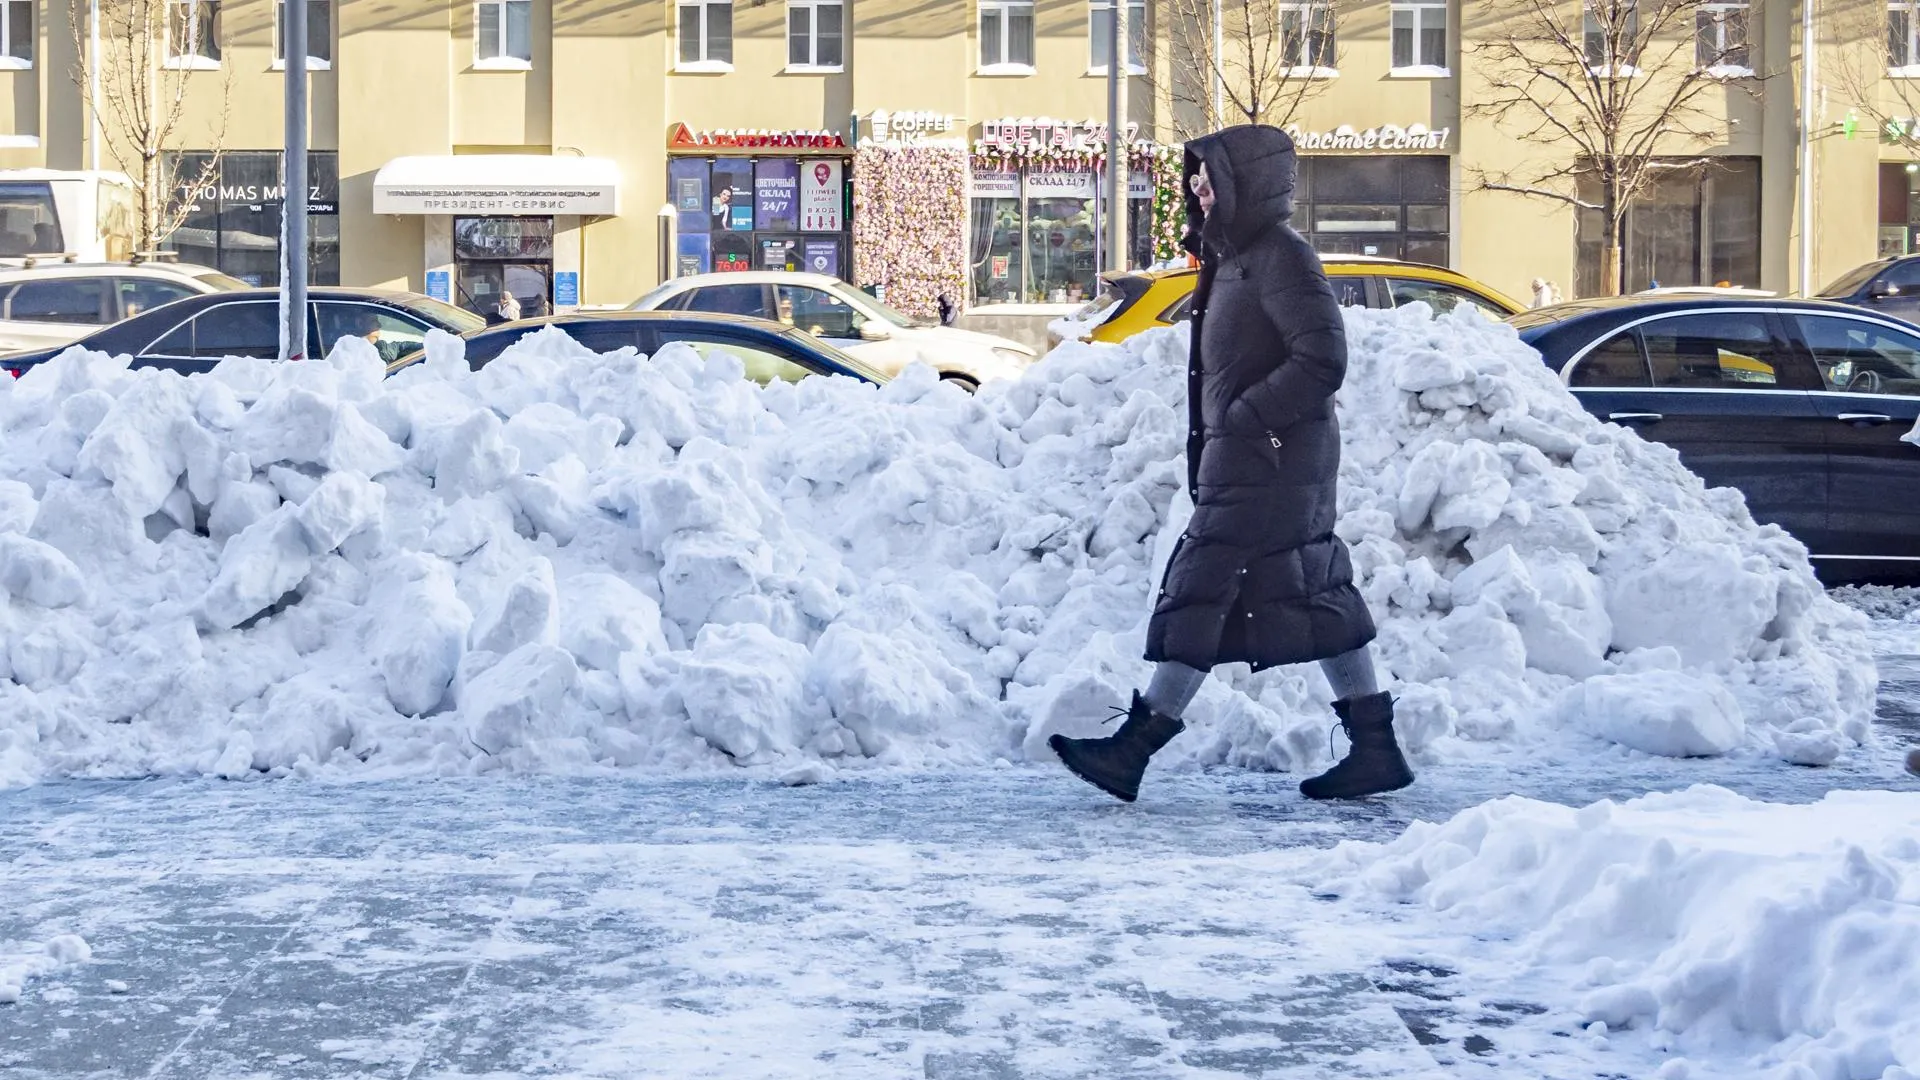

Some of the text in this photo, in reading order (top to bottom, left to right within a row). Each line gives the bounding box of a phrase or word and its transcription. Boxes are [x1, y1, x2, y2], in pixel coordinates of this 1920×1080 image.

[892, 113, 953, 131] COFFEE
[983, 122, 1138, 147] ЦВЕТЫ 247
[1378, 125, 1449, 149] Есть!
[755, 176, 796, 188] ЦВЕТОЧНЫЙ
[1029, 177, 1086, 187] СКЛАД 24/7
[182, 186, 257, 200] THOMAS
[759, 189, 791, 199] СКЛАД
[424, 200, 566, 209] ПРЕЗИДЕНТ-СЕРВИС
[762, 201, 789, 212] 24/7
[716, 261, 749, 272] 76.00
